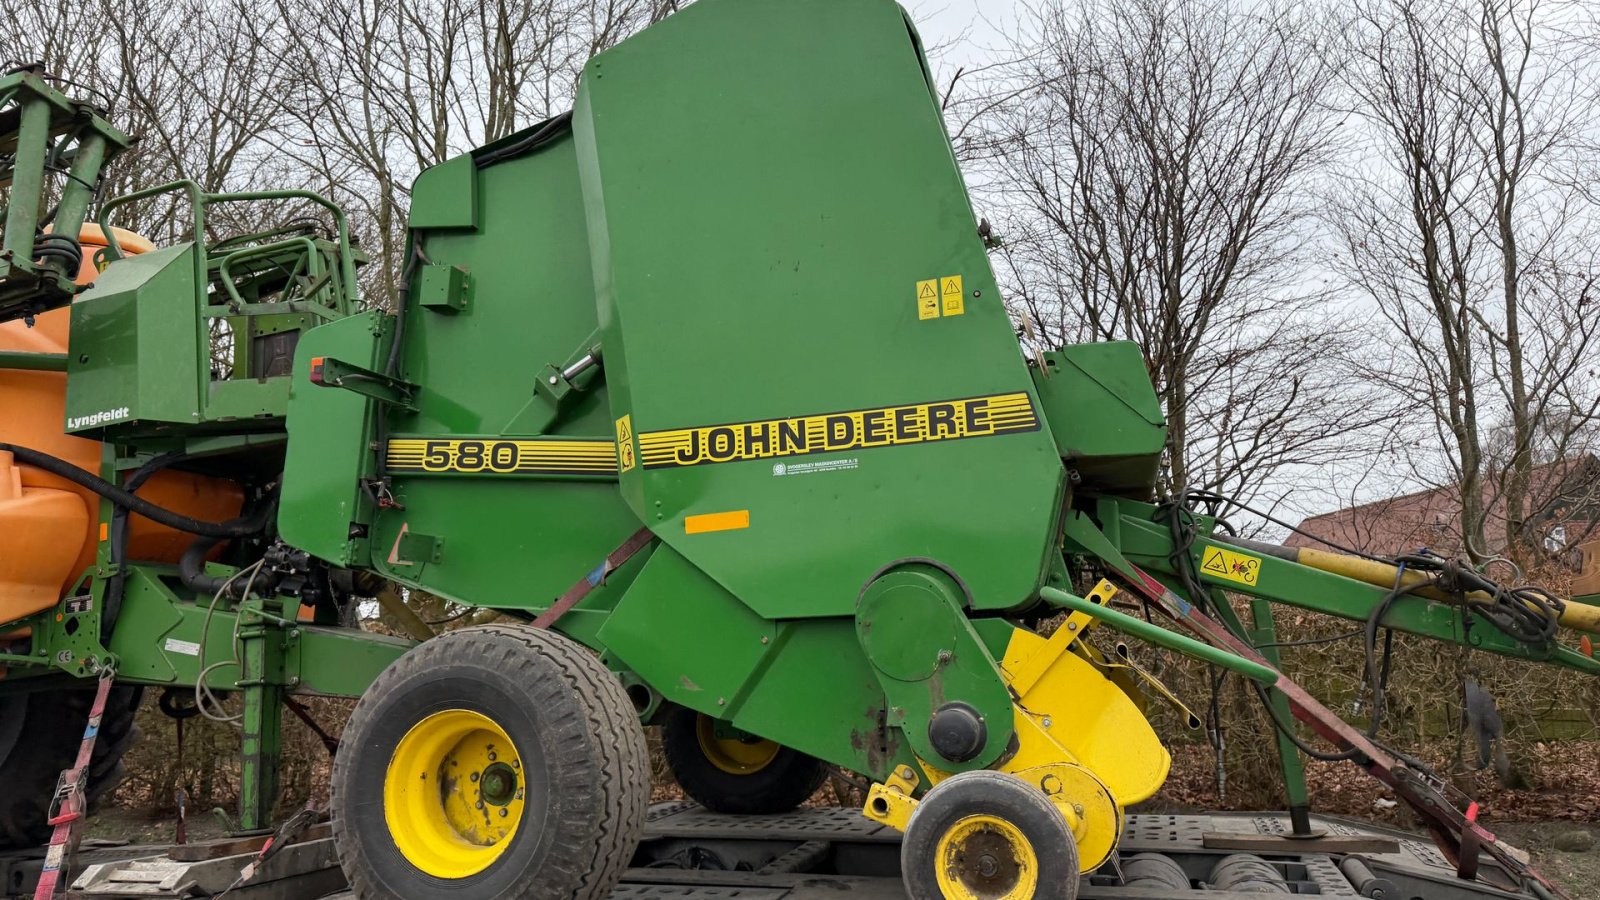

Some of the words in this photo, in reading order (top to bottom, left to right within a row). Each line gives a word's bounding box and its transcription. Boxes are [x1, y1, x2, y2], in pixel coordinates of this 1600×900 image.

[67, 407, 129, 429] Lyngfeldt
[676, 419, 808, 465] JOHN
[825, 399, 992, 450] DEERE
[423, 440, 519, 472] 580
